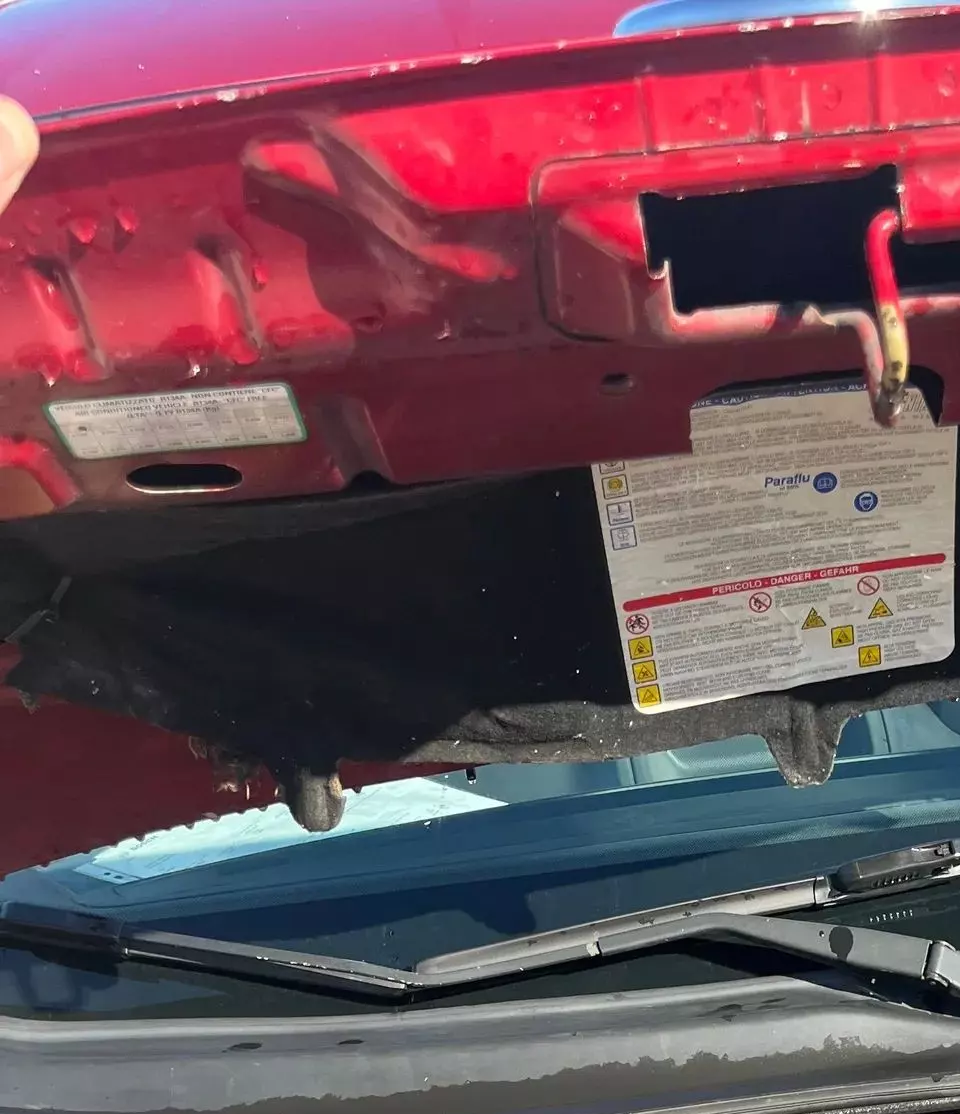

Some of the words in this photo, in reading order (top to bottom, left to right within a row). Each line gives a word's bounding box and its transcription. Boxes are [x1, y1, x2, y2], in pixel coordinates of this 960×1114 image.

[764, 473, 811, 488] Paraflu
[711, 580, 762, 595] PERICOLO
[770, 572, 812, 586] DANGER
[819, 565, 860, 578] GEFAHR
